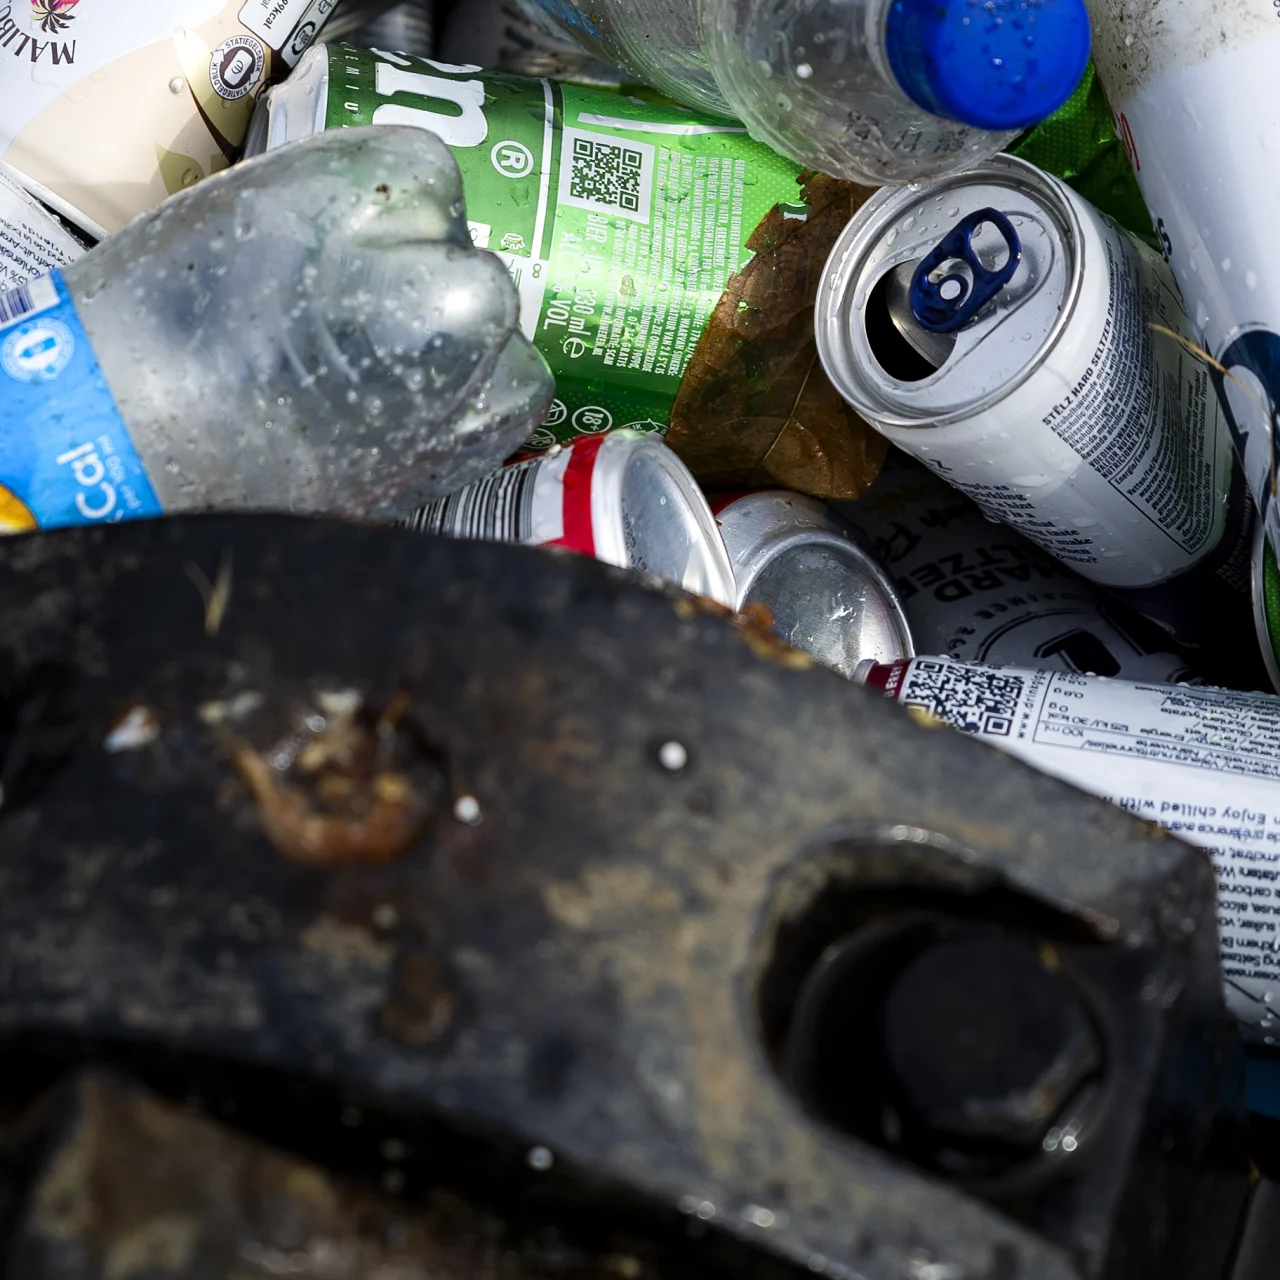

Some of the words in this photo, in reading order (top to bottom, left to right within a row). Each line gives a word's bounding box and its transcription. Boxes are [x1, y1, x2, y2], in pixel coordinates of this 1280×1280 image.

[585, 214, 607, 241] BIER
[575, 287, 596, 314] 330
[543, 298, 569, 331] VOL.
[567, 316, 591, 335] ml
[1041, 395, 1075, 426] STËLZ
[1070, 366, 1095, 397] HARD
[1090, 318, 1114, 366] SELTZER
[1118, 794, 1156, 813] with
[1159, 798, 1216, 821] chilled
[1221, 804, 1267, 827] Enjoy
